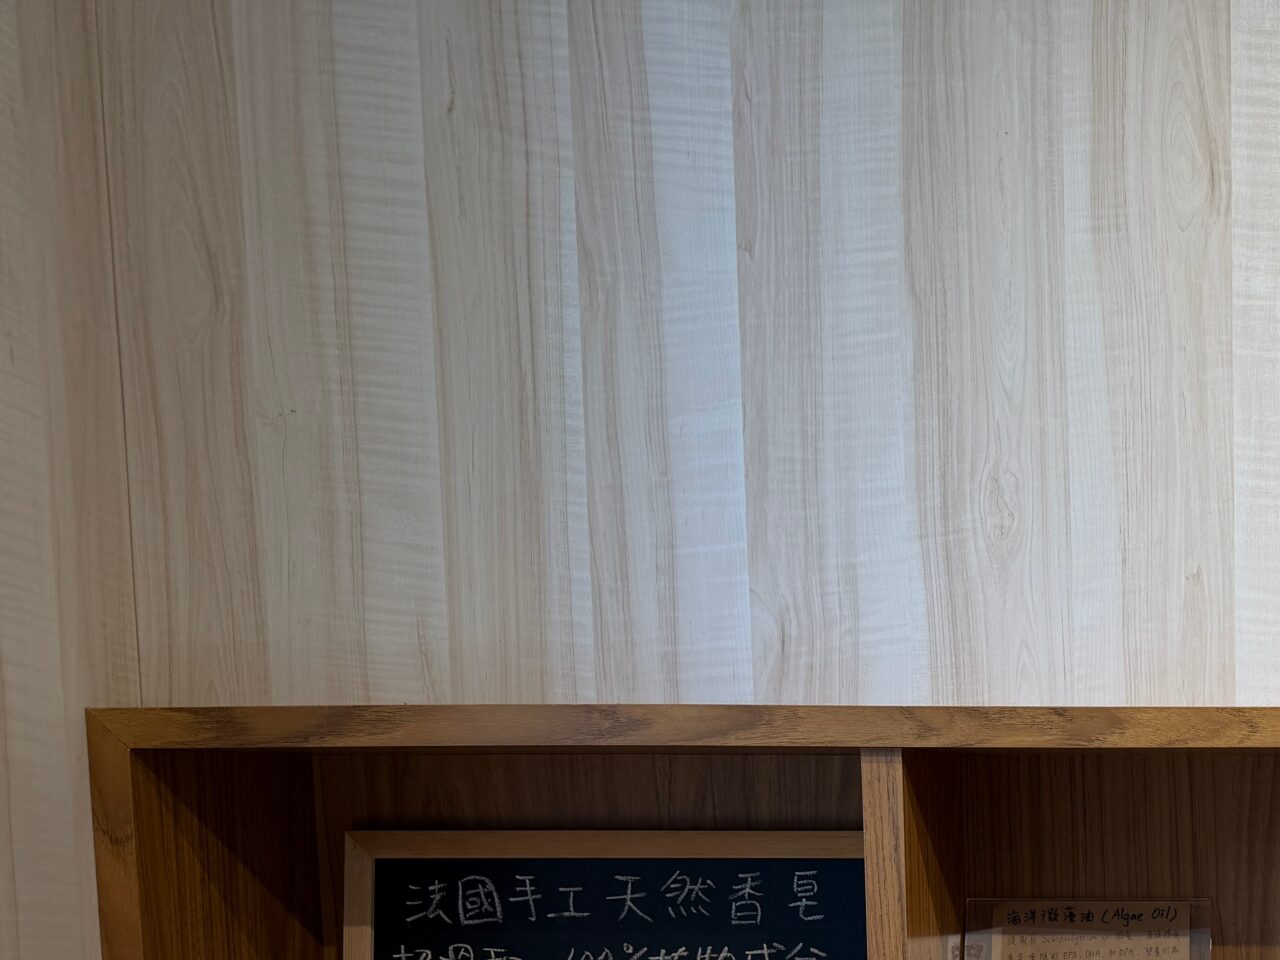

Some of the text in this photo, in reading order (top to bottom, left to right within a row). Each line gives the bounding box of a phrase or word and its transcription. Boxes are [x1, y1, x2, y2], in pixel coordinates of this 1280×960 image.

[406, 870, 825, 926] 法國手工天然香皂
